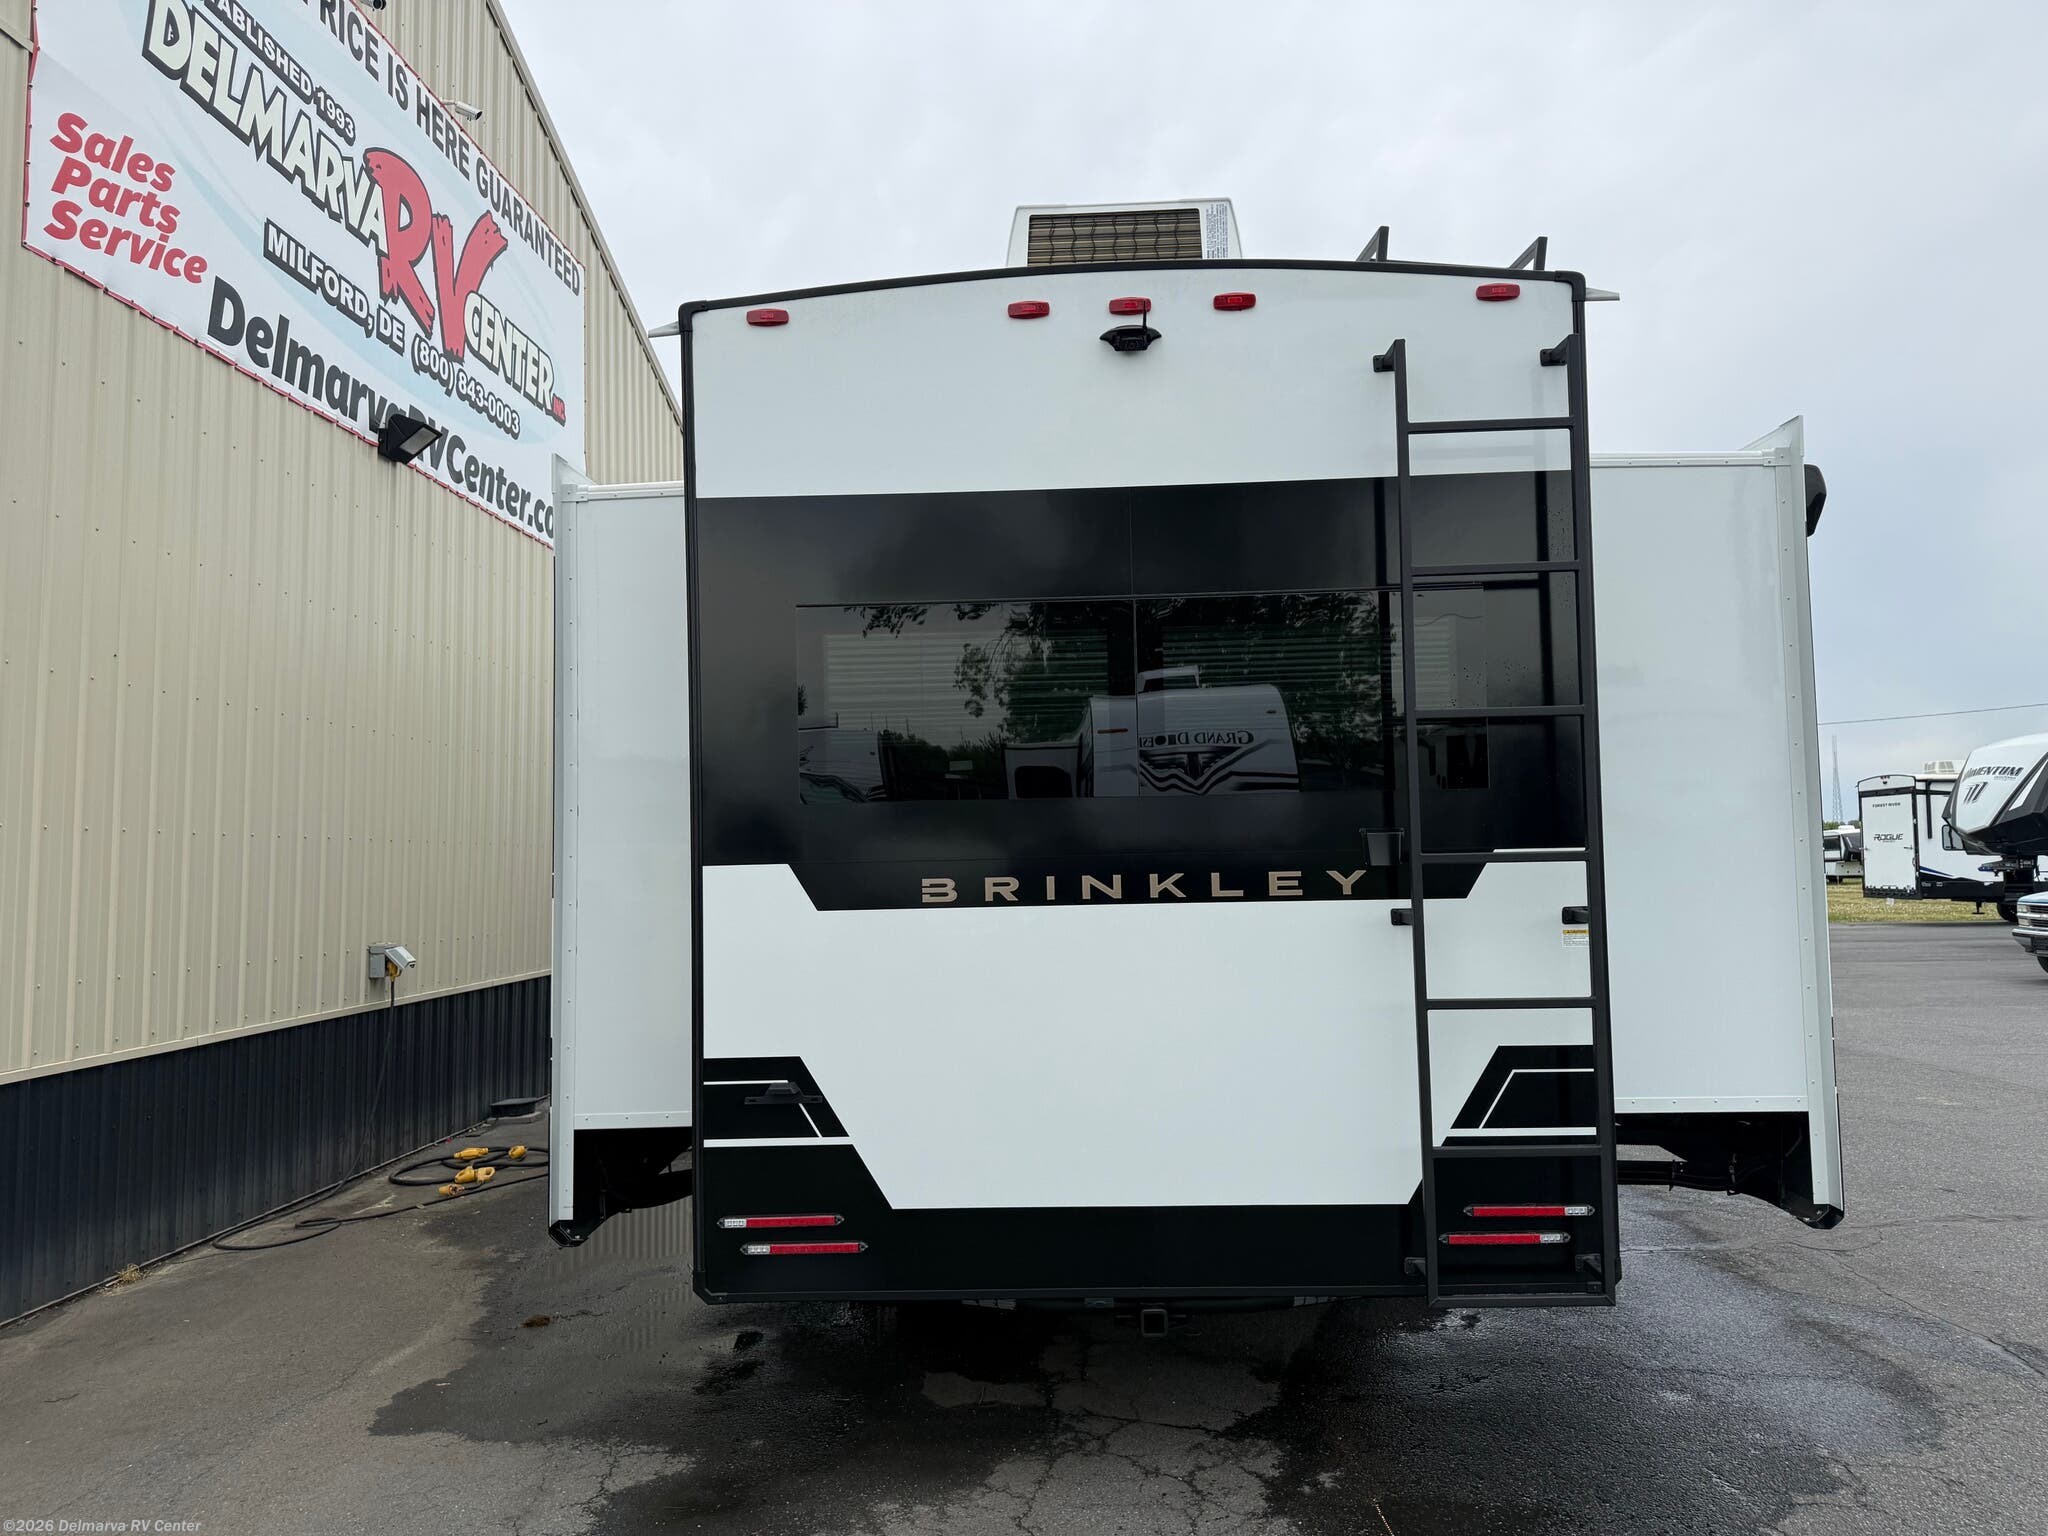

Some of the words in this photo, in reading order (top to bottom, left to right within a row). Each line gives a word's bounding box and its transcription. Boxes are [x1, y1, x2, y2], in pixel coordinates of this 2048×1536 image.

[142, 0, 389, 256] DELMARVA
[212, 0, 313, 97] ABLISHED
[316, 90, 356, 141] 1993
[50, 112, 176, 192] Sales
[51, 156, 181, 234] Parts
[302, 0, 379, 81] RICE
[387, 53, 409, 111] IS
[416, 85, 470, 181] HERE
[476, 157, 580, 296] GUARANTEED
[43, 200, 208, 284] Service
[364, 147, 508, 362] RV
[265, 220, 374, 331] MILFORD,
[378, 306, 405, 349] DE
[413, 336, 455, 392] (800)
[457, 370, 521, 436] 843-0003
[463, 290, 554, 413] CENTER
[207, 275, 554, 539] DelmarvVCenter.co
[921, 869, 1367, 904] BRINKLEY
[1873, 833, 1904, 841] ROGUE
